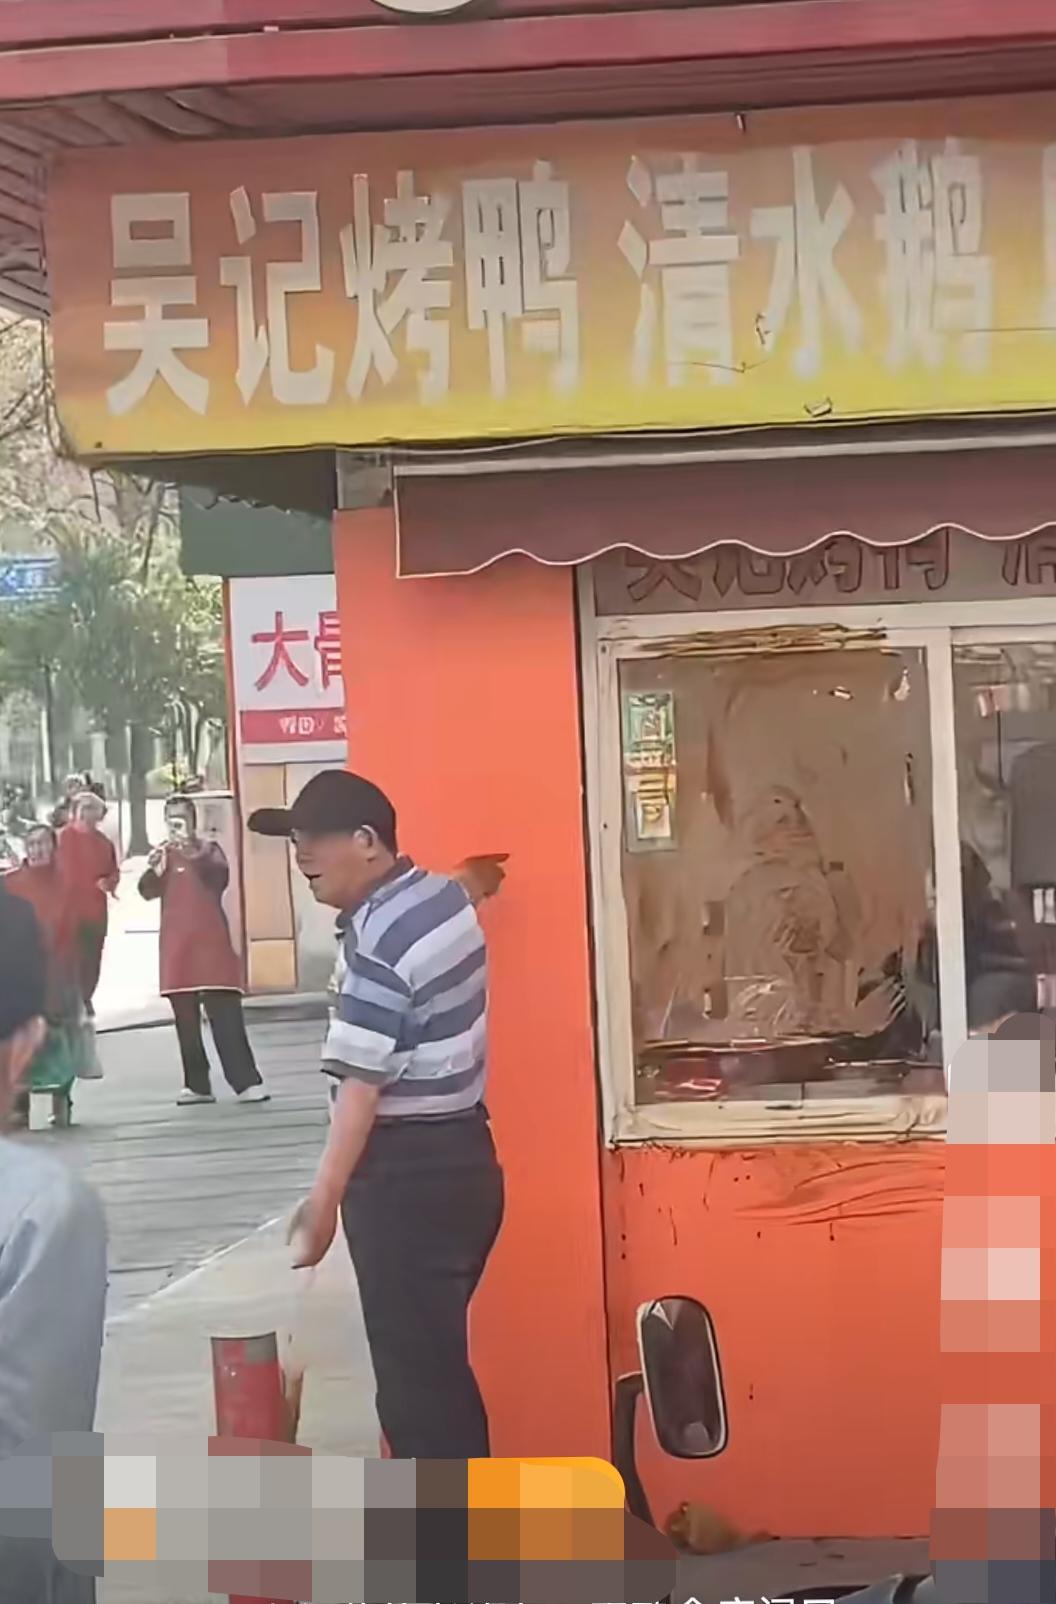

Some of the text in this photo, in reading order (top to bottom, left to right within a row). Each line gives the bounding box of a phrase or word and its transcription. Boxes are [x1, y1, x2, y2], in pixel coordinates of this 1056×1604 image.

[104, 160, 579, 416] 吴记烤鸭
[617, 137, 994, 388] 清水鹅
